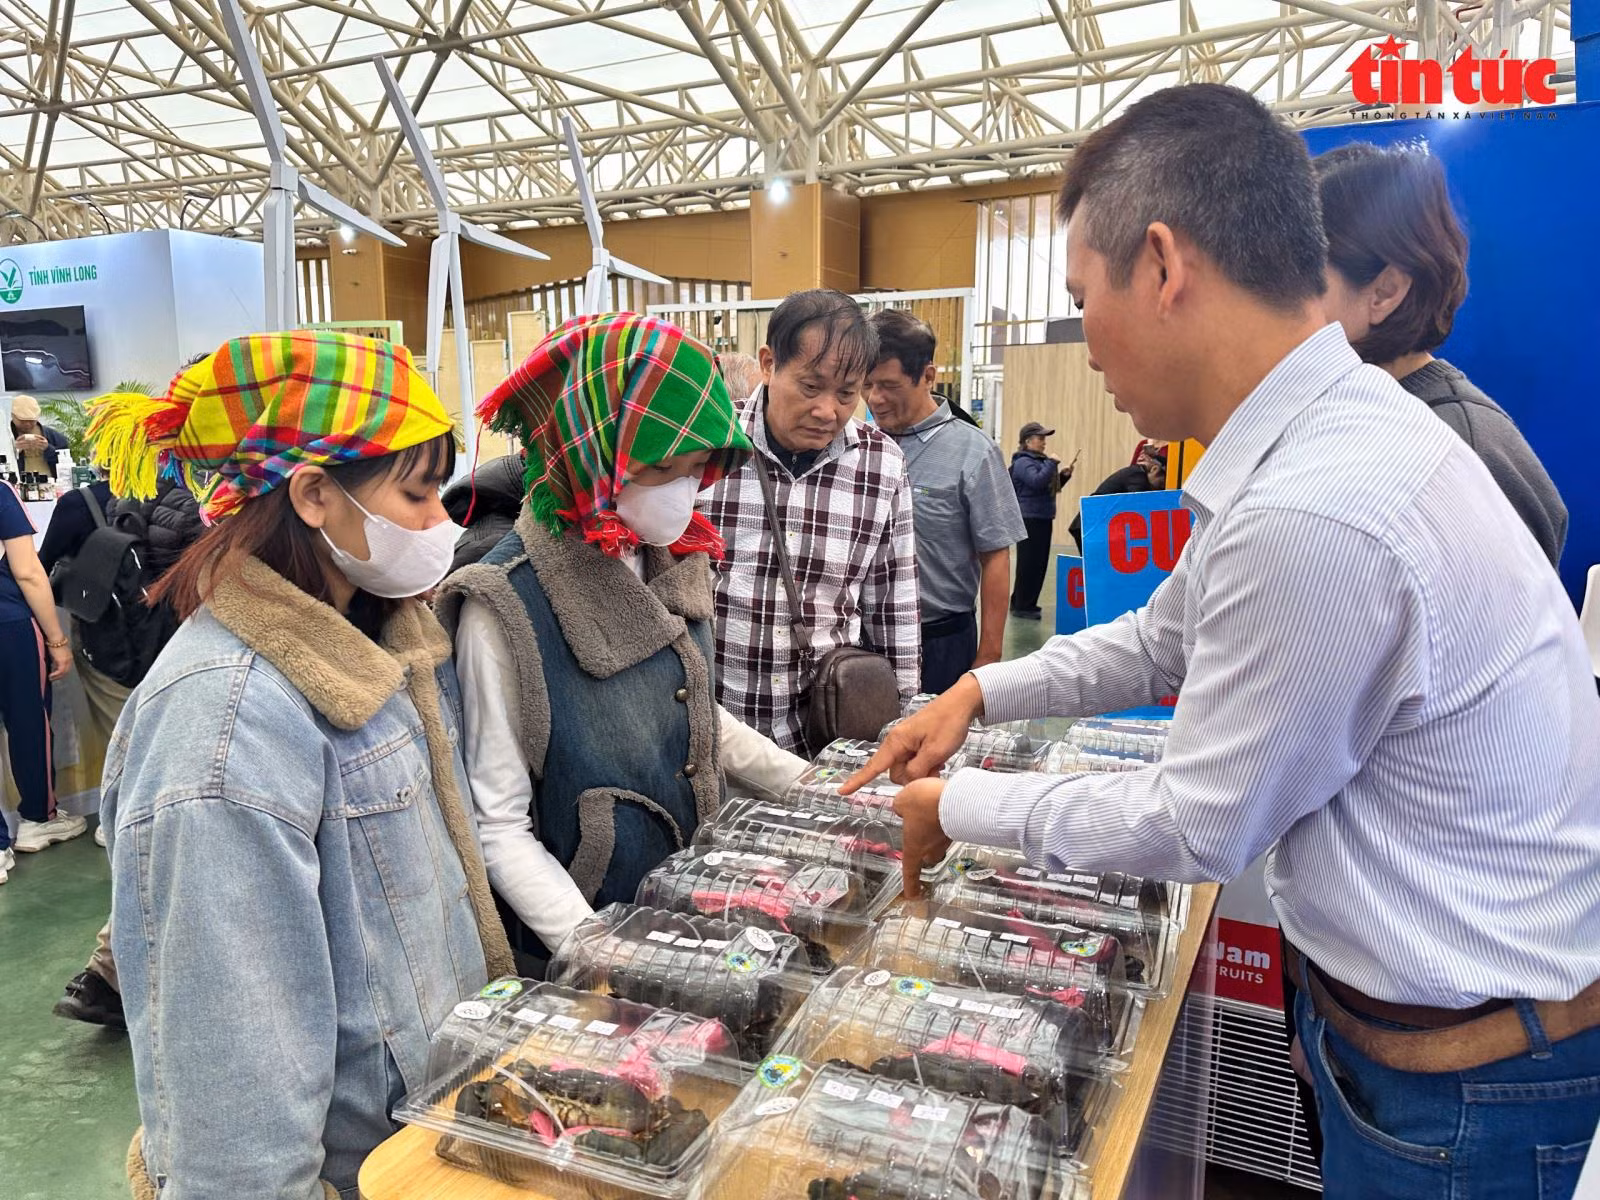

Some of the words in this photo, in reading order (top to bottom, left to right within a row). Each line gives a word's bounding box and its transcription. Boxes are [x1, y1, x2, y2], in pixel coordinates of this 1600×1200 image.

[28, 265, 50, 286] TỈNH
[51, 265, 72, 284] VĨNH
[73, 264, 97, 282] LONG
[1214, 963, 1265, 985] RUITS
